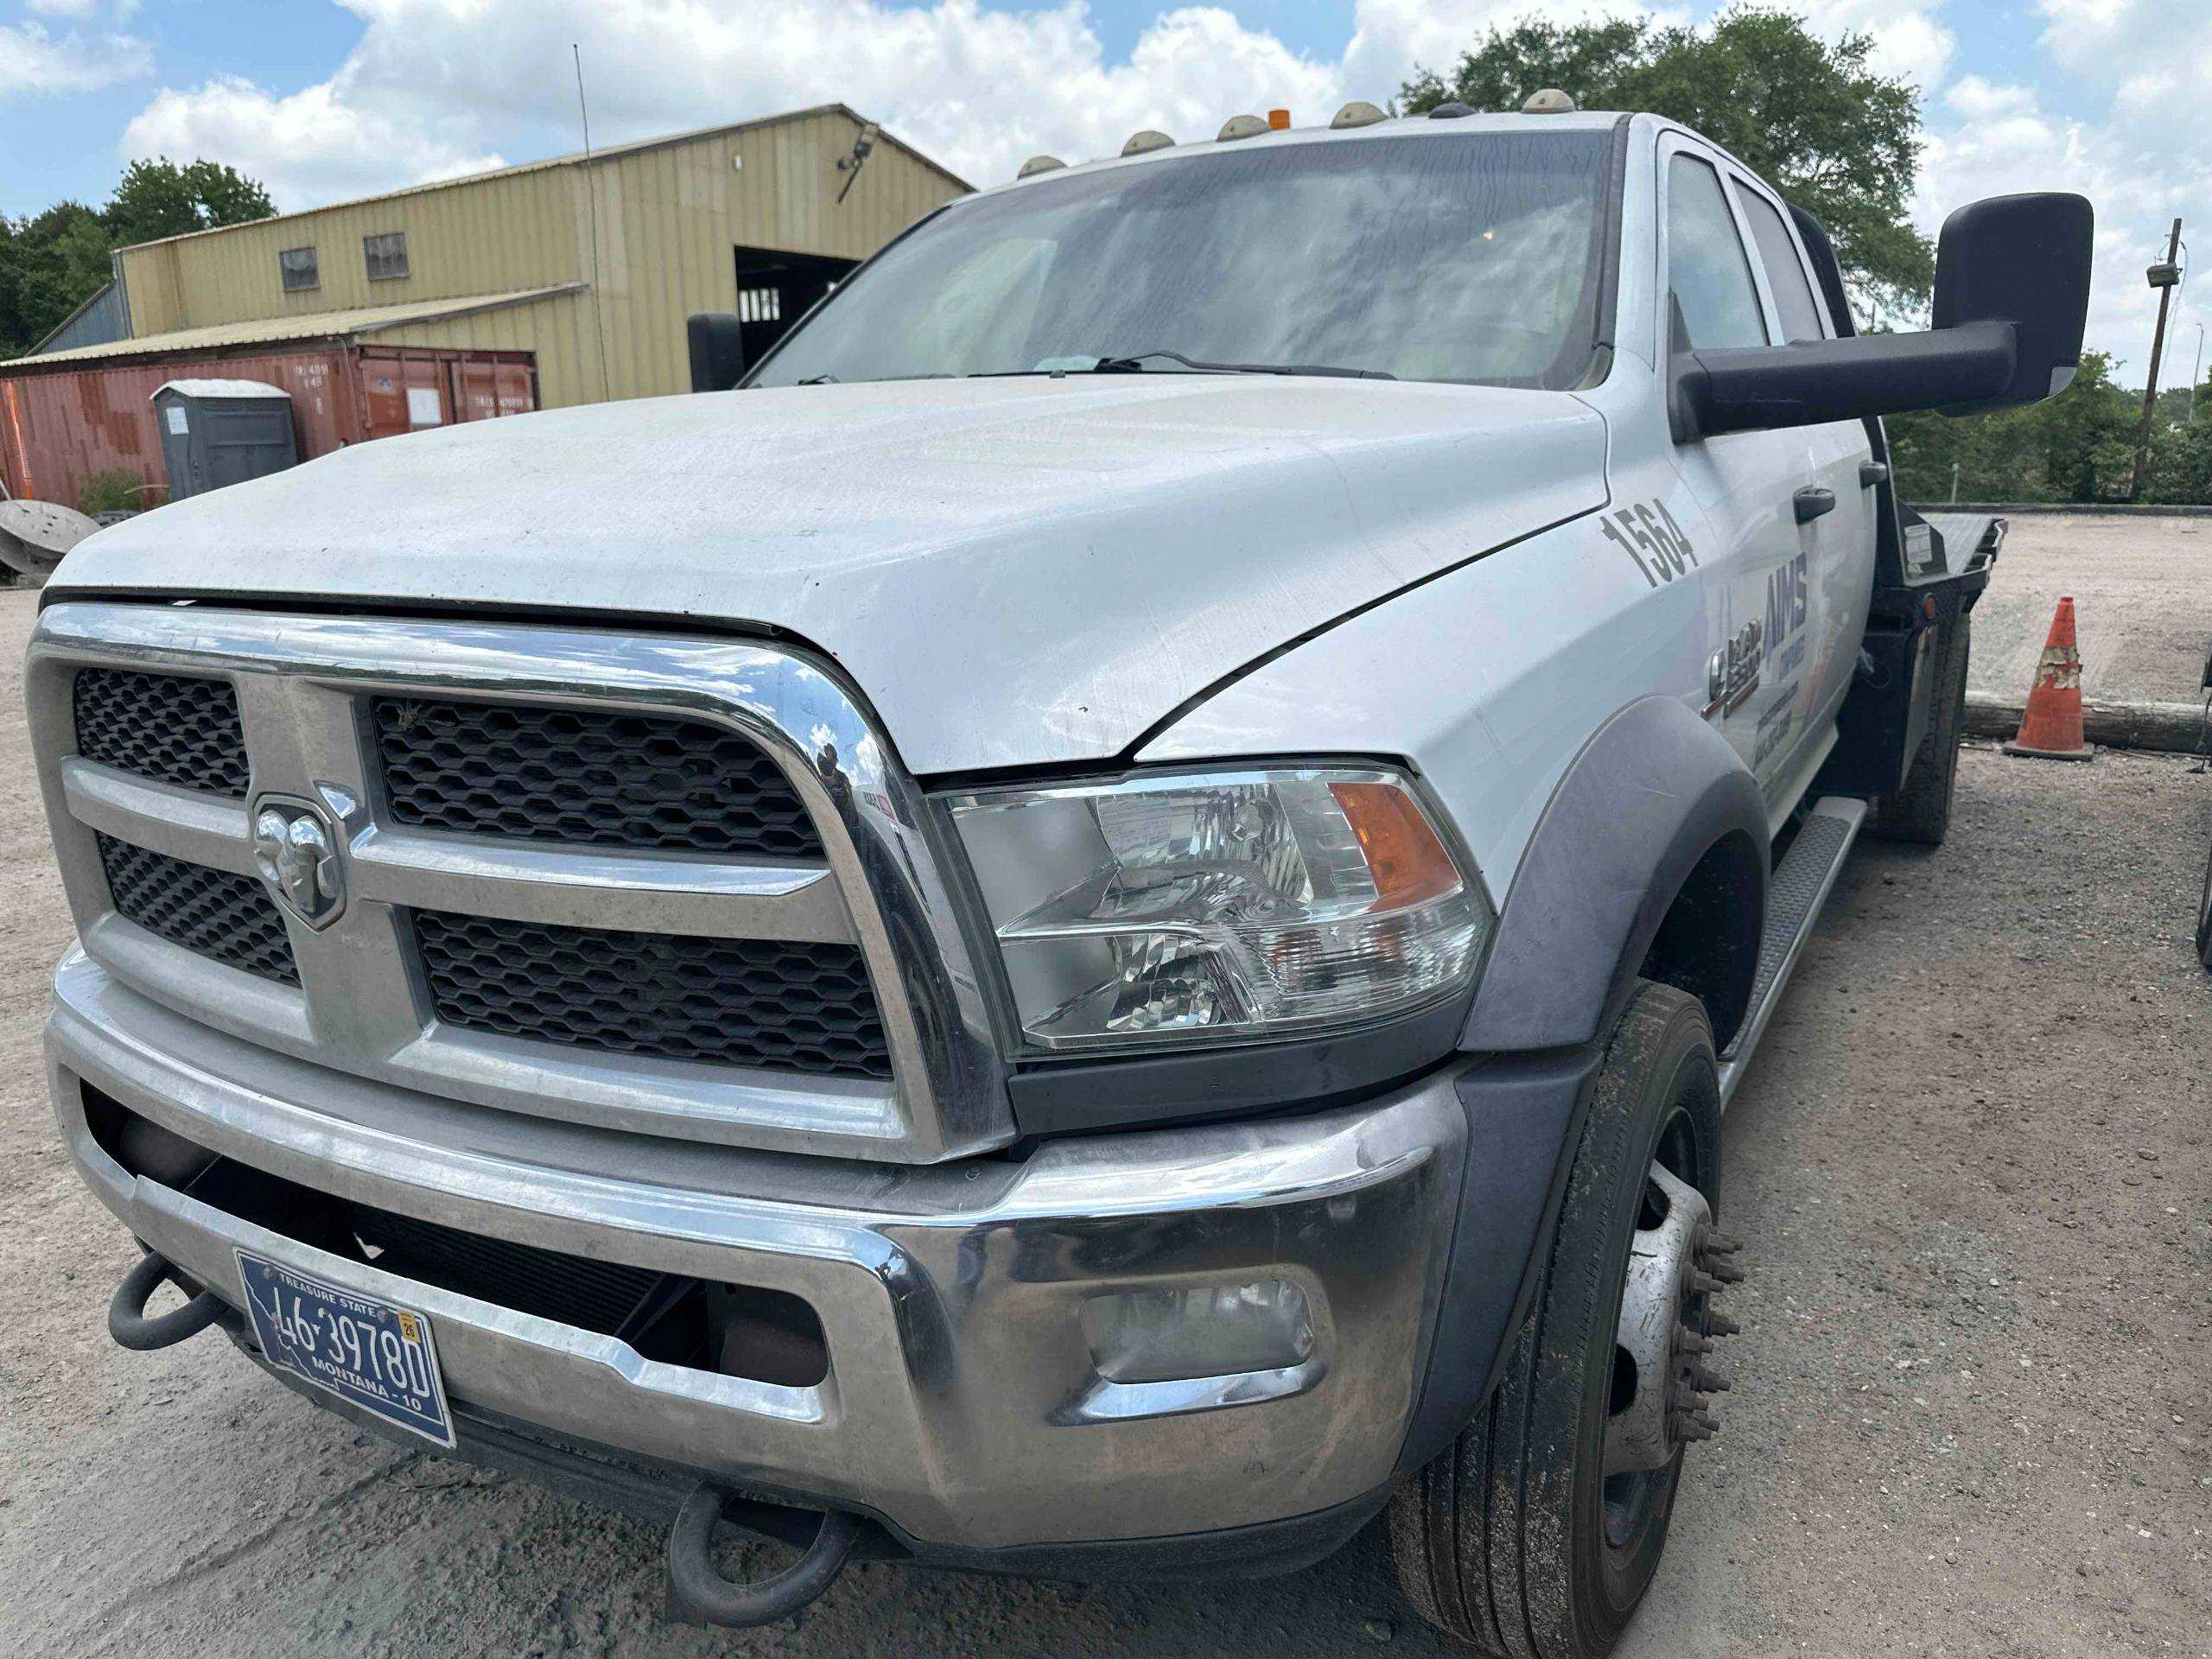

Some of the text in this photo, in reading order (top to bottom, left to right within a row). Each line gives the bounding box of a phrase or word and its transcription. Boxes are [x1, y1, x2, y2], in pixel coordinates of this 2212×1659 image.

[1599, 498, 1699, 588] 1564
[1761, 550, 1807, 660] AMS
[279, 1274, 337, 1306] TREASURE
[339, 1298, 377, 1319] STATE
[311, 1356, 390, 1398] MONTANA
[404, 1395, 423, 1412] 10
